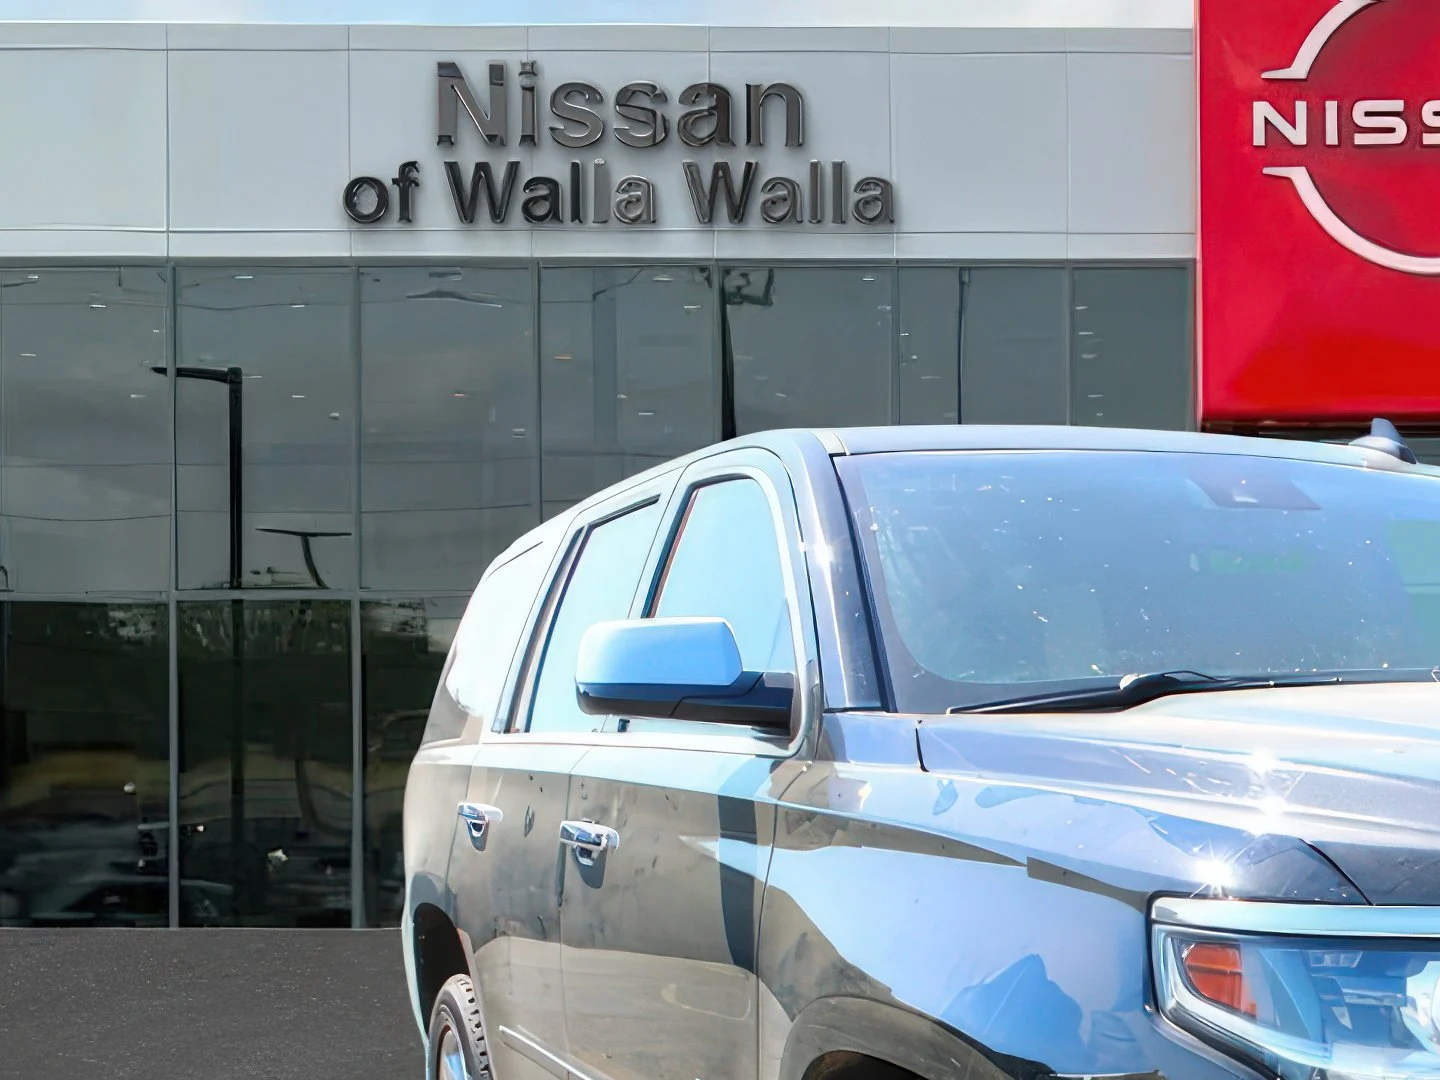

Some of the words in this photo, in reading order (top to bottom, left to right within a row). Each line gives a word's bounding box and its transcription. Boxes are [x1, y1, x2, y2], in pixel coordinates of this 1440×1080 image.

[436, 60, 806, 148] Nissan
[342, 160, 421, 224] of
[443, 159, 657, 224] Walla
[682, 159, 896, 224] Walla
